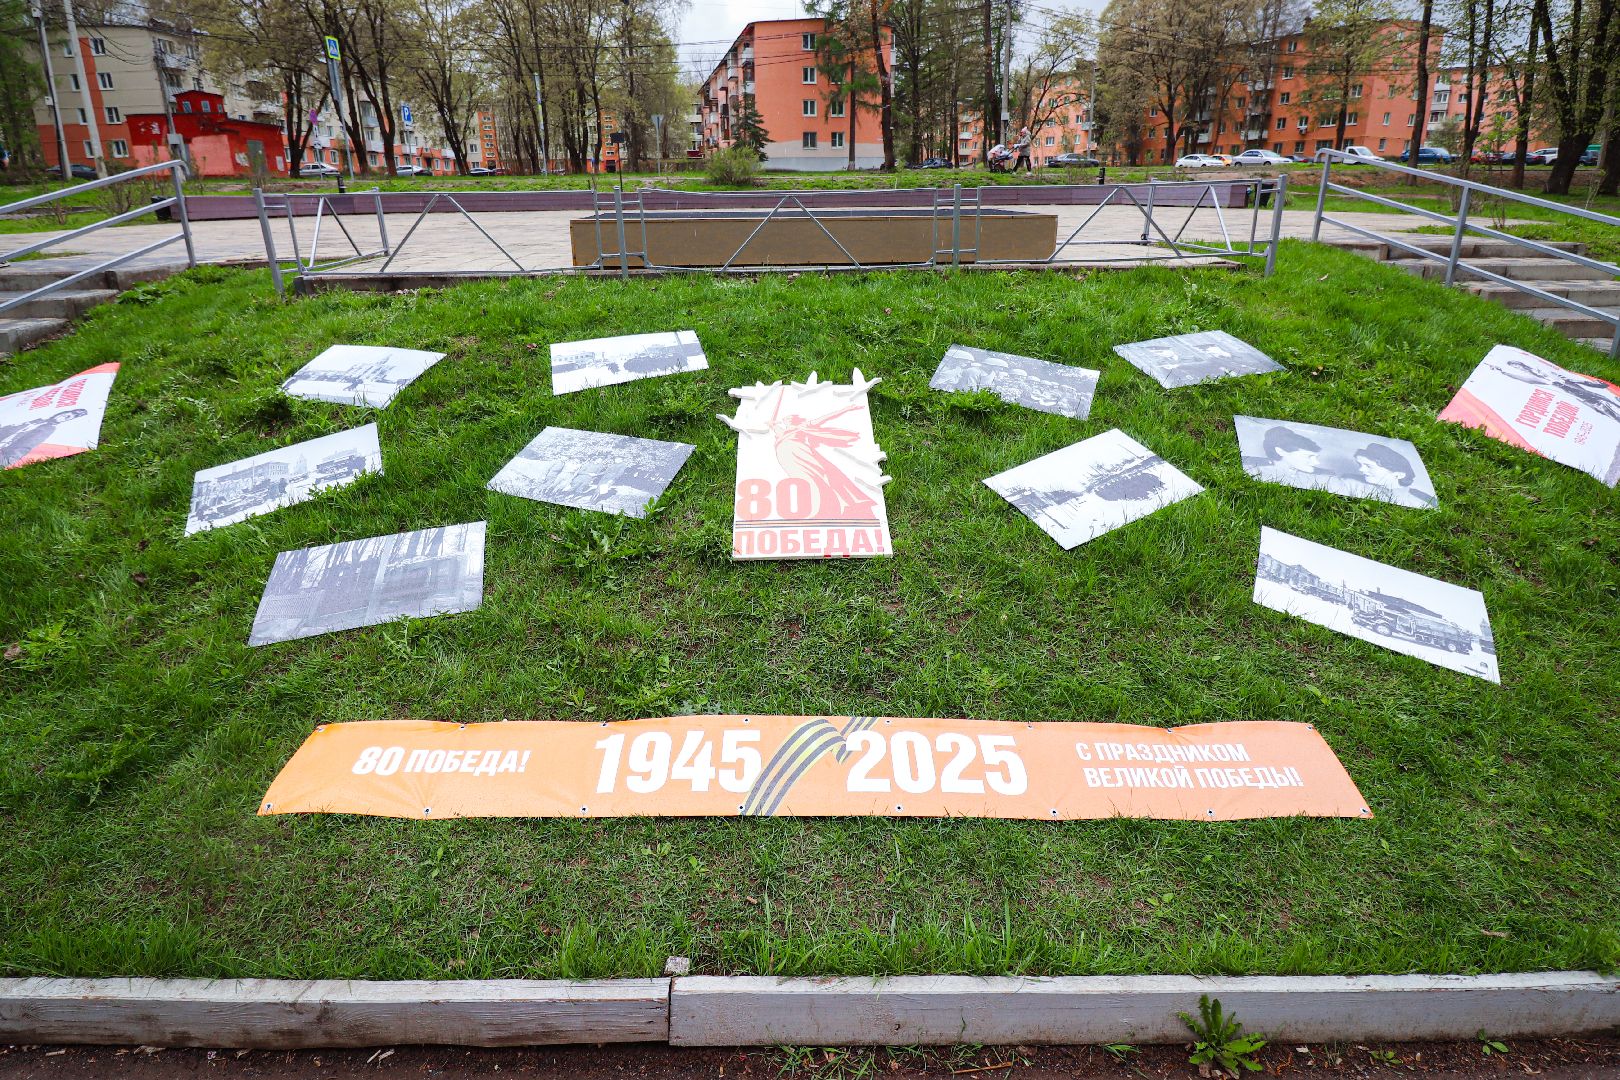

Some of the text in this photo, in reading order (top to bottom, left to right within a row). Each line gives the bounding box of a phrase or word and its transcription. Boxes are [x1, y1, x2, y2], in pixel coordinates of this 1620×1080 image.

[1514, 388, 1556, 429] ГОРДИМСЯ
[1543, 400, 1580, 438] ПОБЕДОЙ
[736, 477, 812, 520] 80
[734, 528, 885, 558] ПОБЕДА!
[352, 746, 531, 776] 80 ПОБЕДА!
[594, 729, 762, 794] 1945
[846, 730, 1028, 796] 2025
[1075, 742, 1252, 763] С ПРАЗДНИКОМ
[1082, 765, 1304, 790] ВЕЛИКОЙ ПОБЕДЫ!
